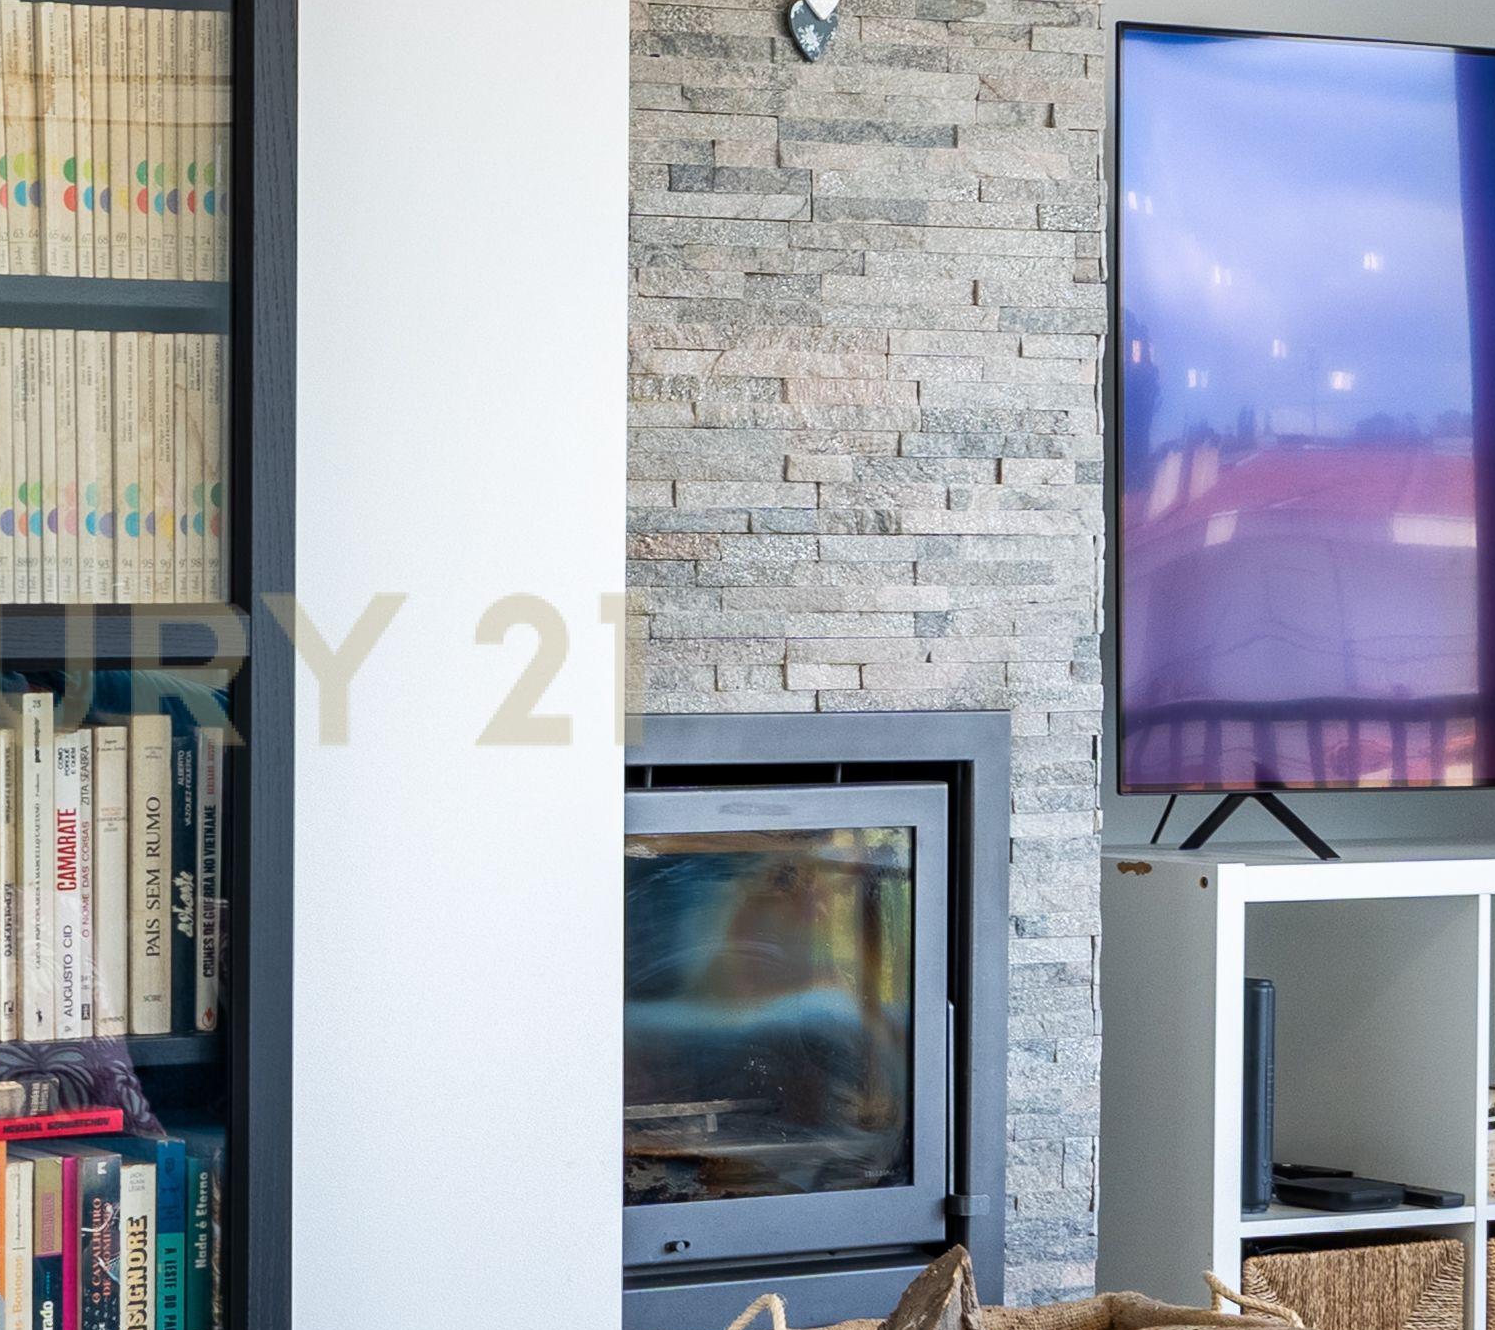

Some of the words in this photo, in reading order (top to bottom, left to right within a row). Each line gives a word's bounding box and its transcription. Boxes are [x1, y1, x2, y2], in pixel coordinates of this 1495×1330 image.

[57, 808, 76, 891] CAMARATE
[146, 797, 161, 857] RUMO
[146, 869, 160, 910] SEM
[146, 919, 160, 956] PAIS
